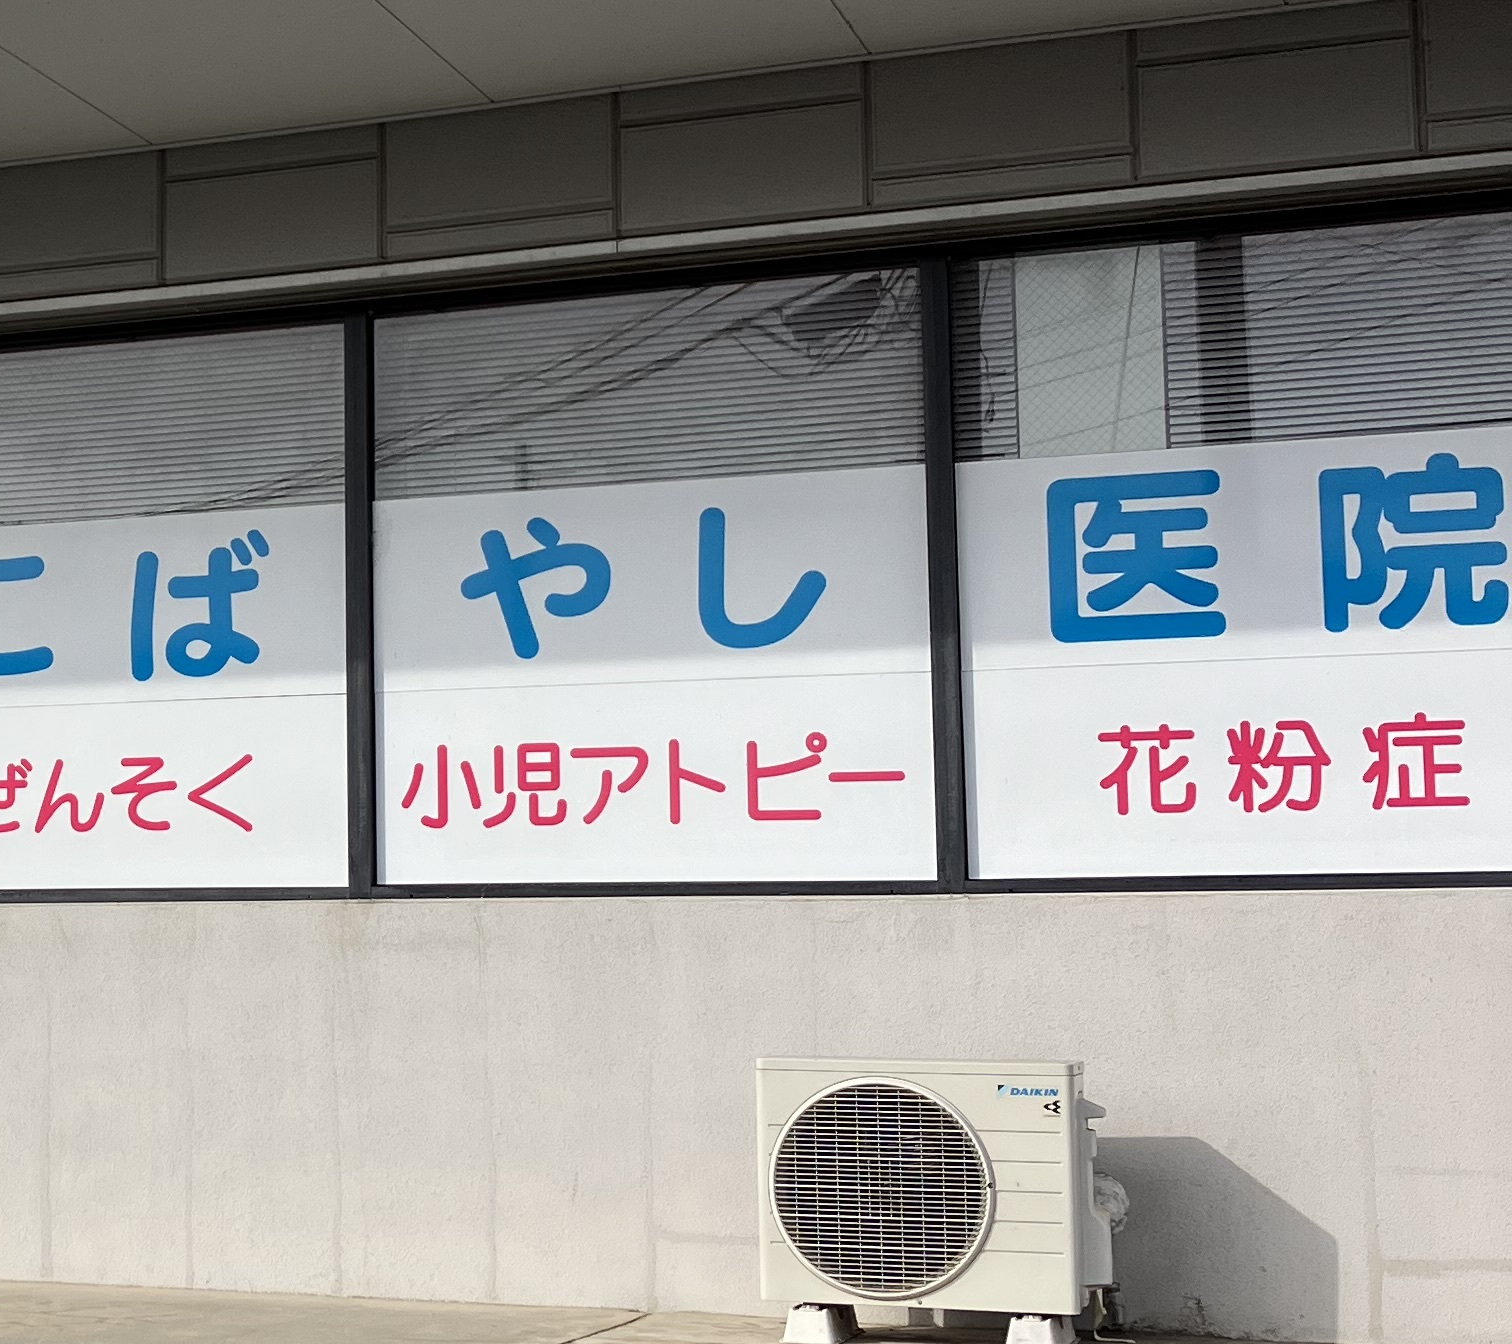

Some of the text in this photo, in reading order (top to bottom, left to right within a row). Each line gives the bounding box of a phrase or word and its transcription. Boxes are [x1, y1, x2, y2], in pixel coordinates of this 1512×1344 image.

[401, 731, 906, 829] 小児アトピー
[1097, 712, 1471, 816] 花粉症
[1010, 1087, 1059, 1097] DAIKIN
